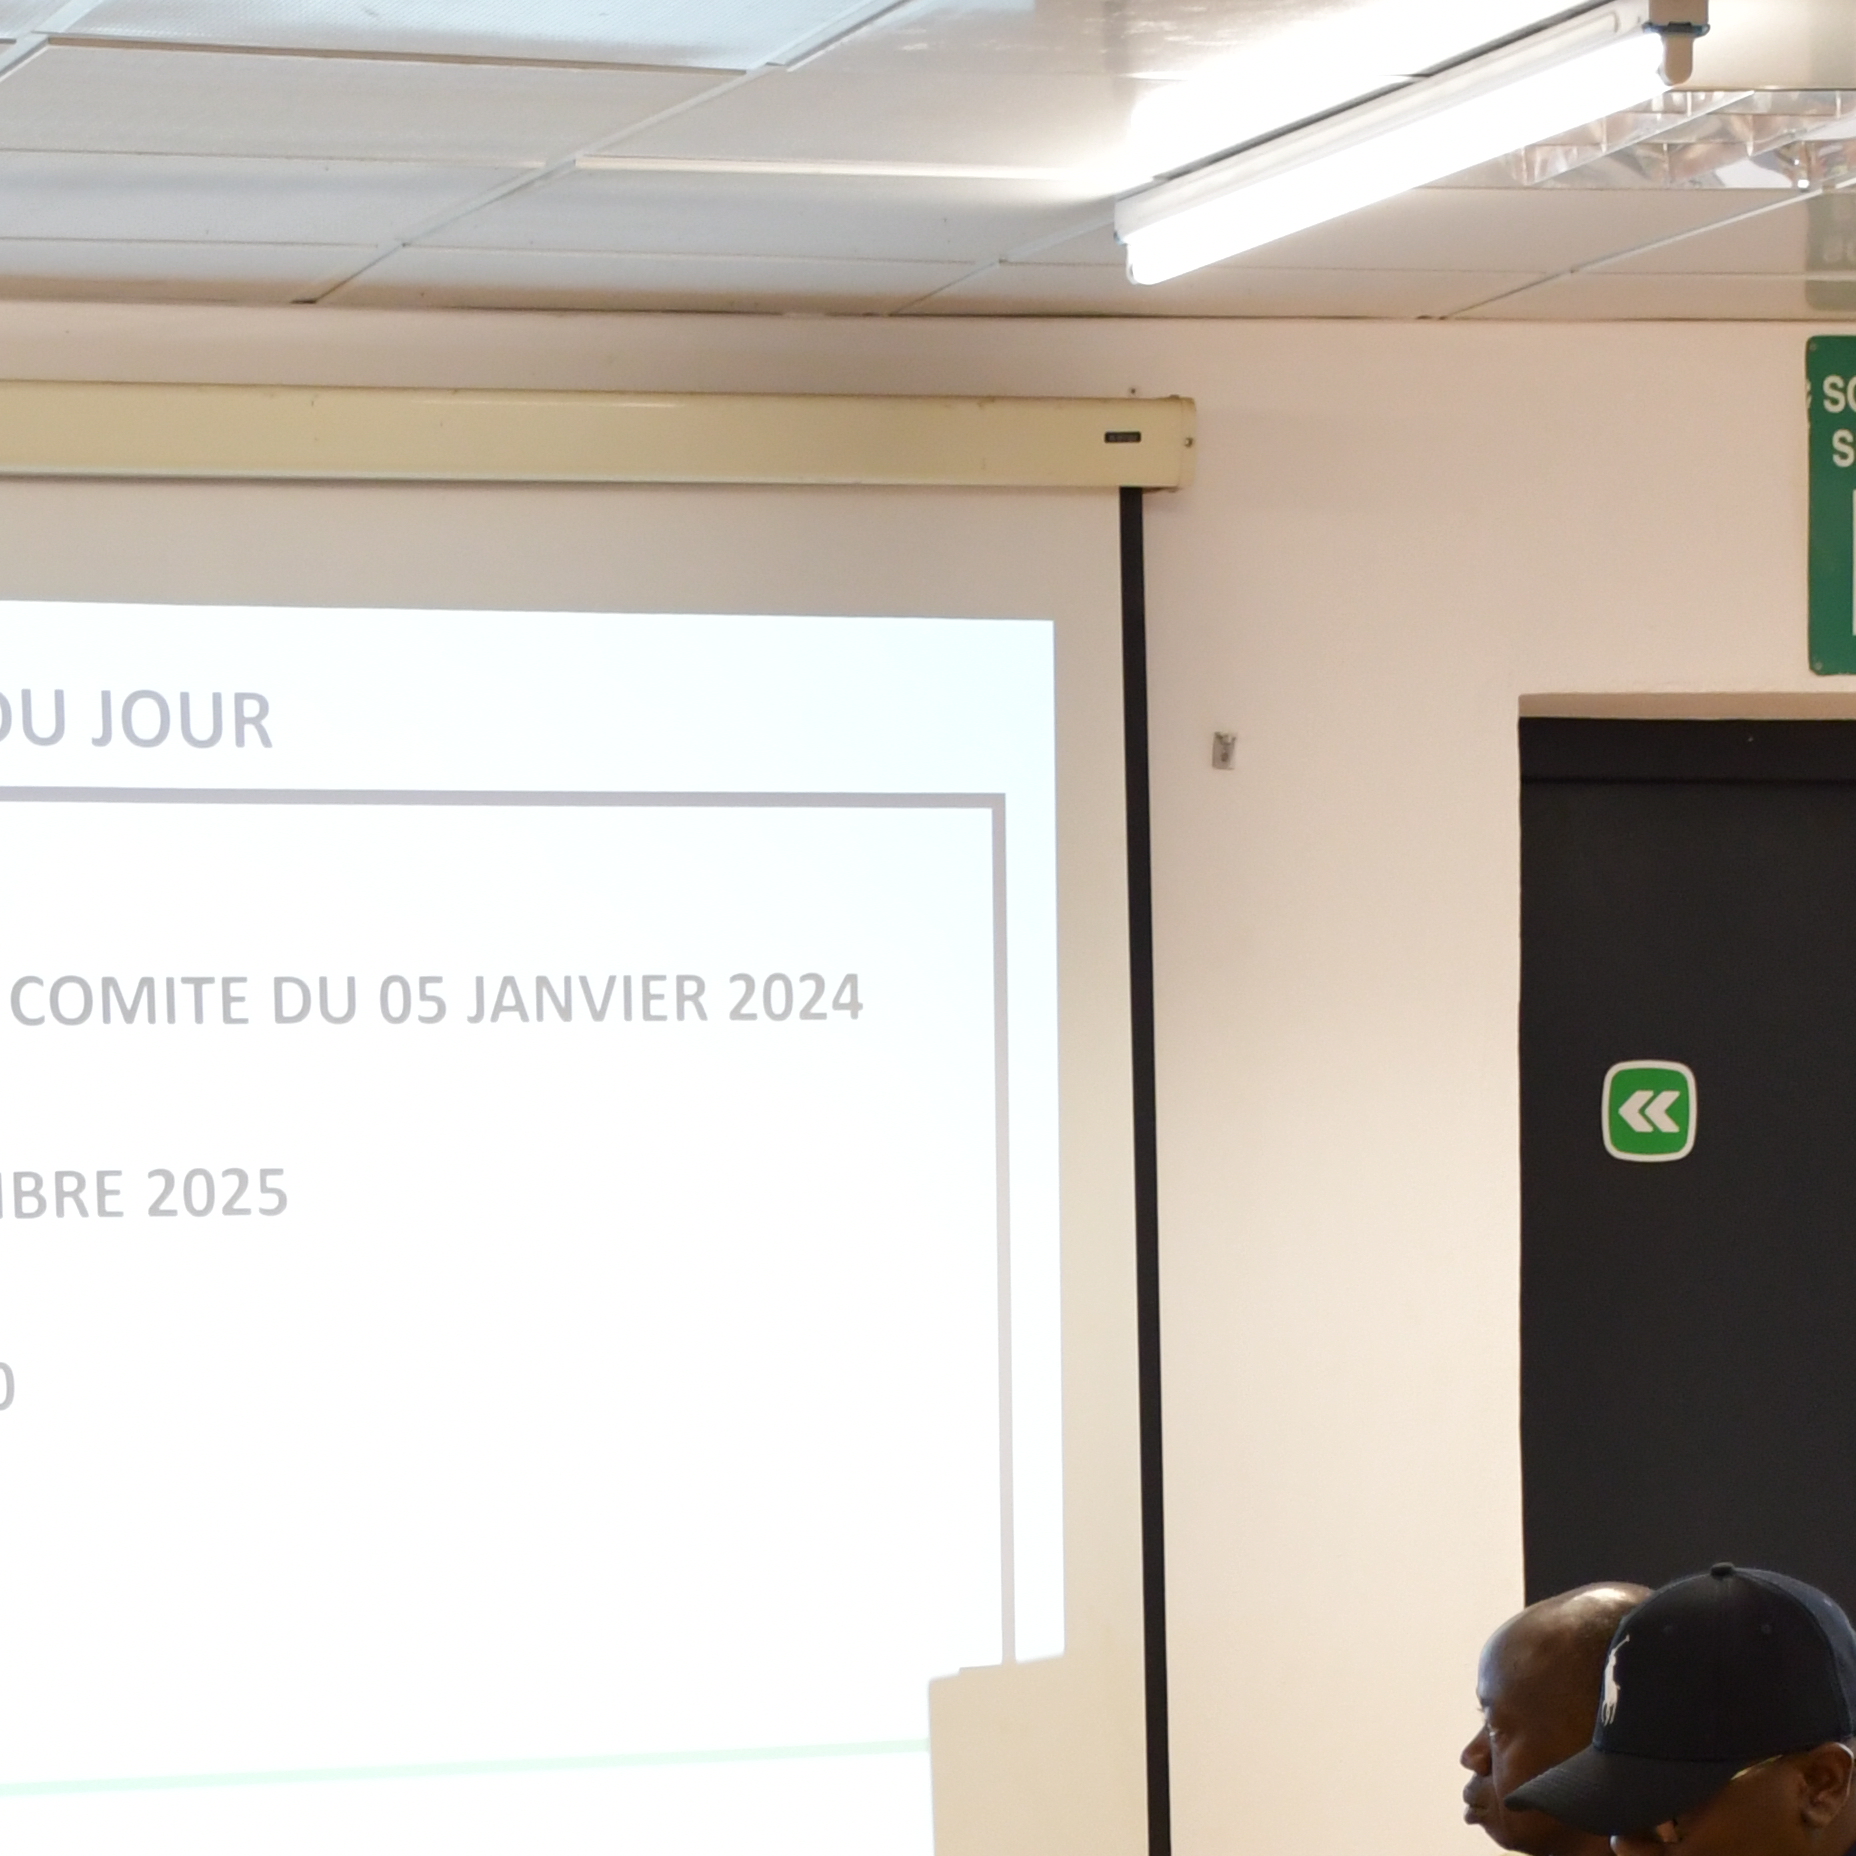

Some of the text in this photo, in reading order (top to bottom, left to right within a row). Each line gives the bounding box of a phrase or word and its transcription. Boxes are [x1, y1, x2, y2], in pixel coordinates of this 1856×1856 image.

[90, 688, 274, 750] JOUR
[9, 974, 250, 1028] COMITE
[272, 974, 358, 1026] DU
[378, 973, 448, 1026] 05
[465, 973, 709, 1025] JANVIER
[728, 971, 865, 1023] 2024
[146, 1166, 289, 1219] 2025
